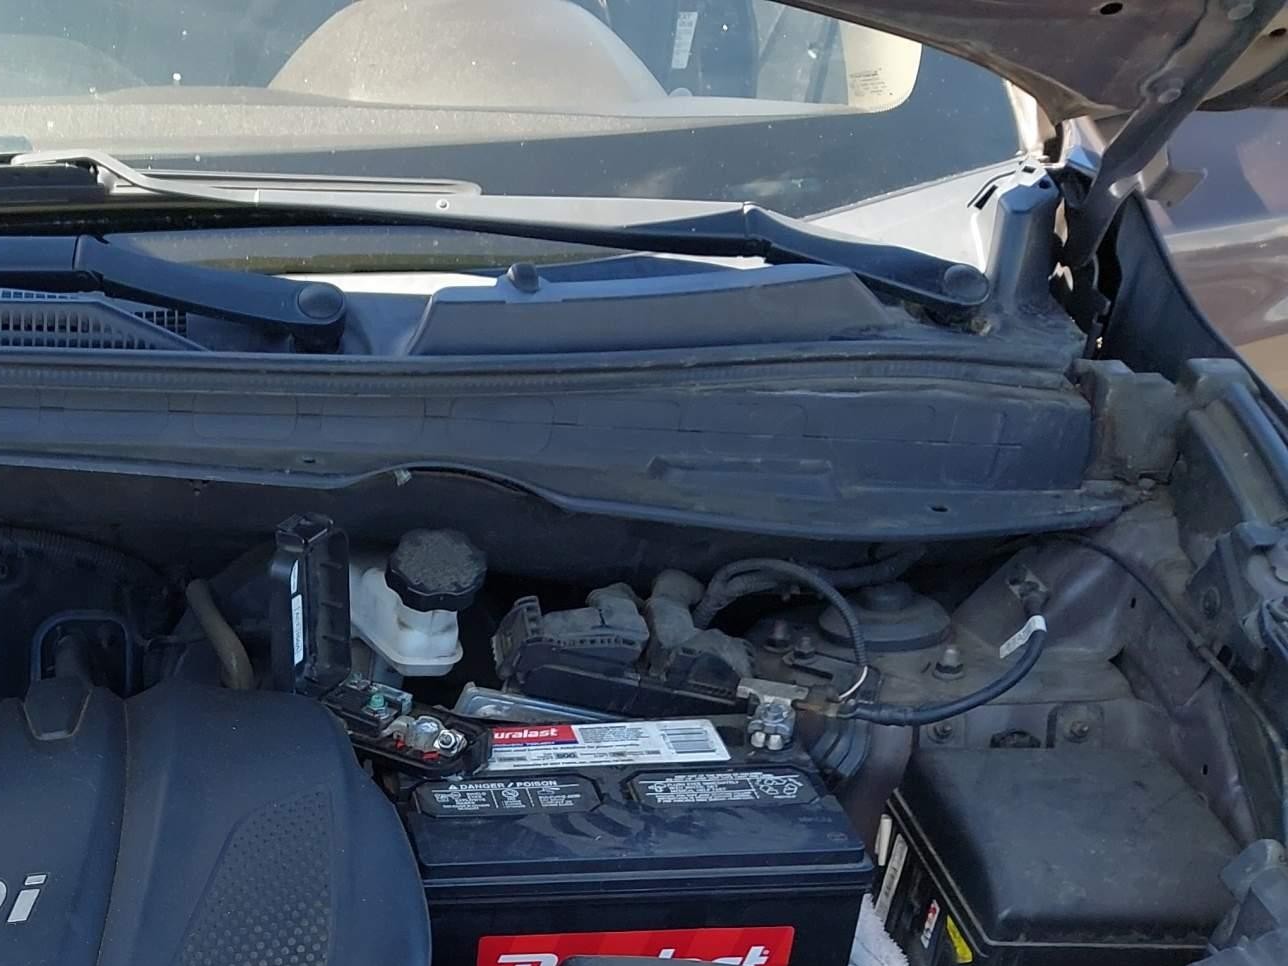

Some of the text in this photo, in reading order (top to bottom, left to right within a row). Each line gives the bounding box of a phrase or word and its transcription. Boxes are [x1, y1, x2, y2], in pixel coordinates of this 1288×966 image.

[494, 727, 559, 739] uralast
[459, 782, 505, 790] DANGER
[516, 780, 557, 788] POISON
